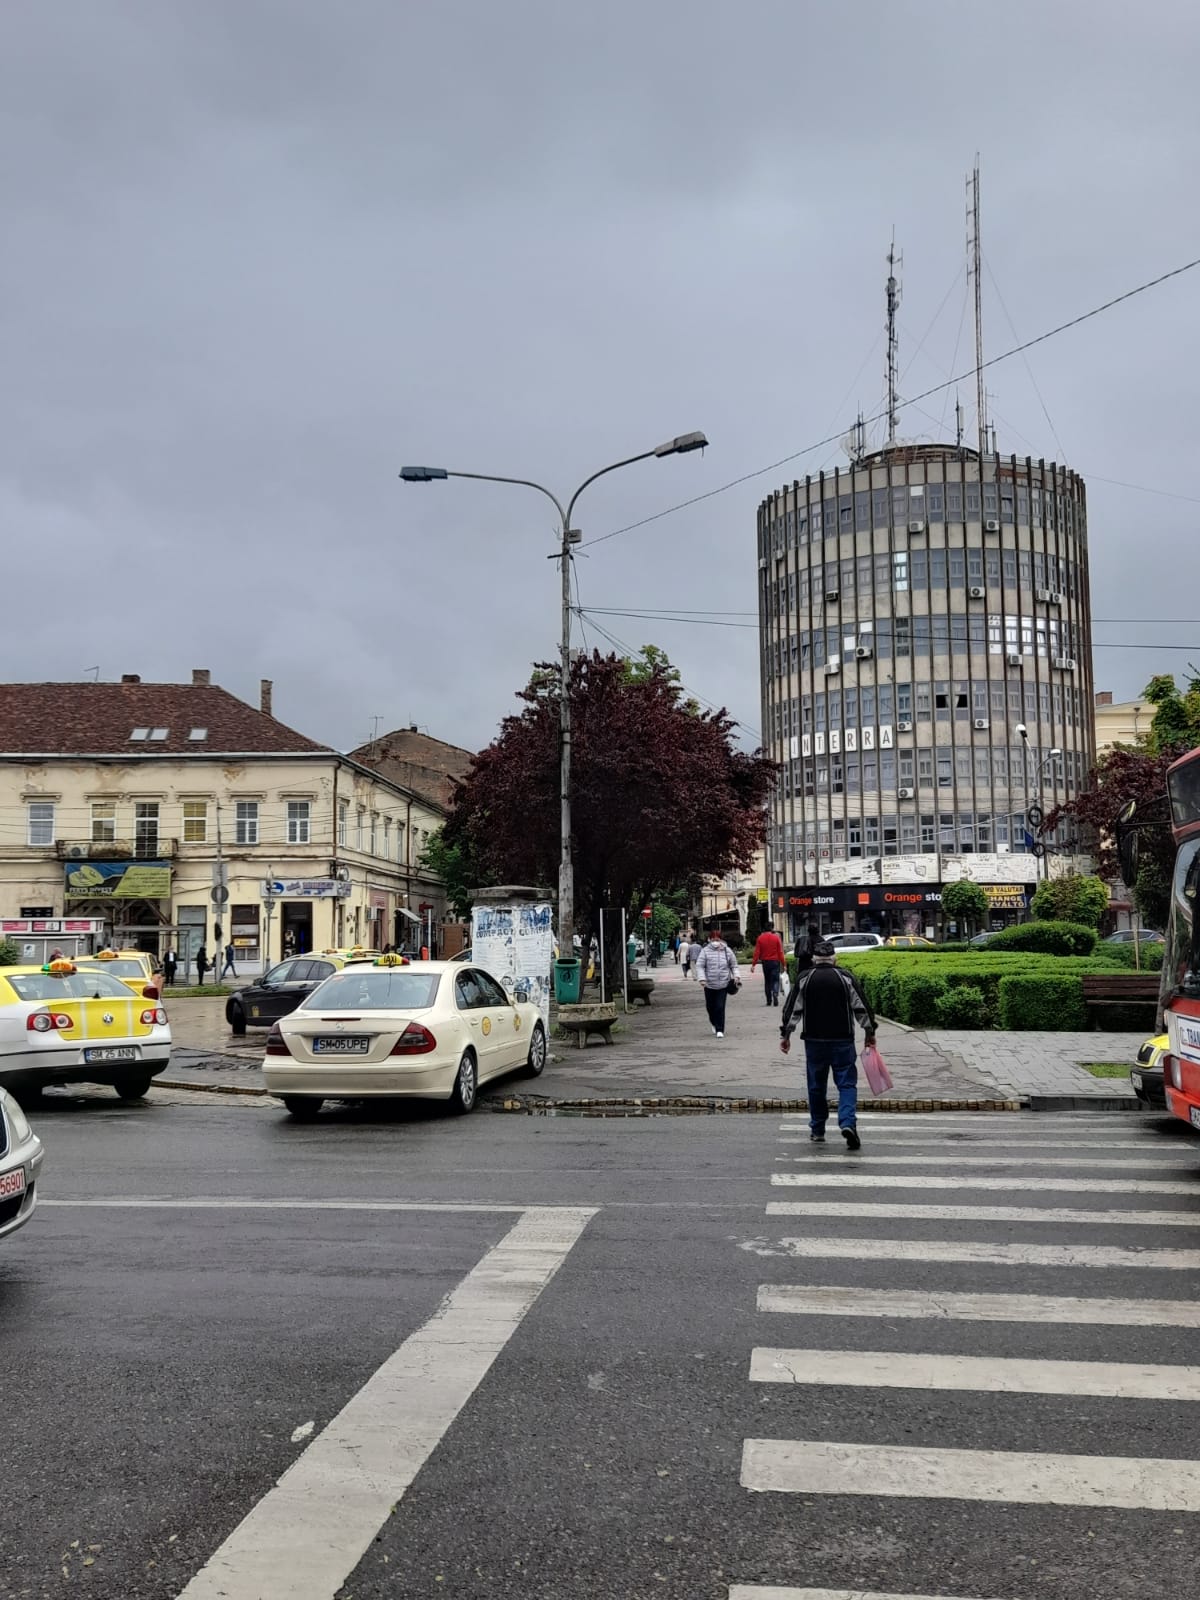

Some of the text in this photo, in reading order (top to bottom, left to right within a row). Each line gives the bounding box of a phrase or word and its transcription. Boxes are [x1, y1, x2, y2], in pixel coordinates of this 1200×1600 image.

[790, 729, 891, 754] INTERRA
[789, 895, 835, 906] Orange store
[884, 892, 942, 903] Orange sto
